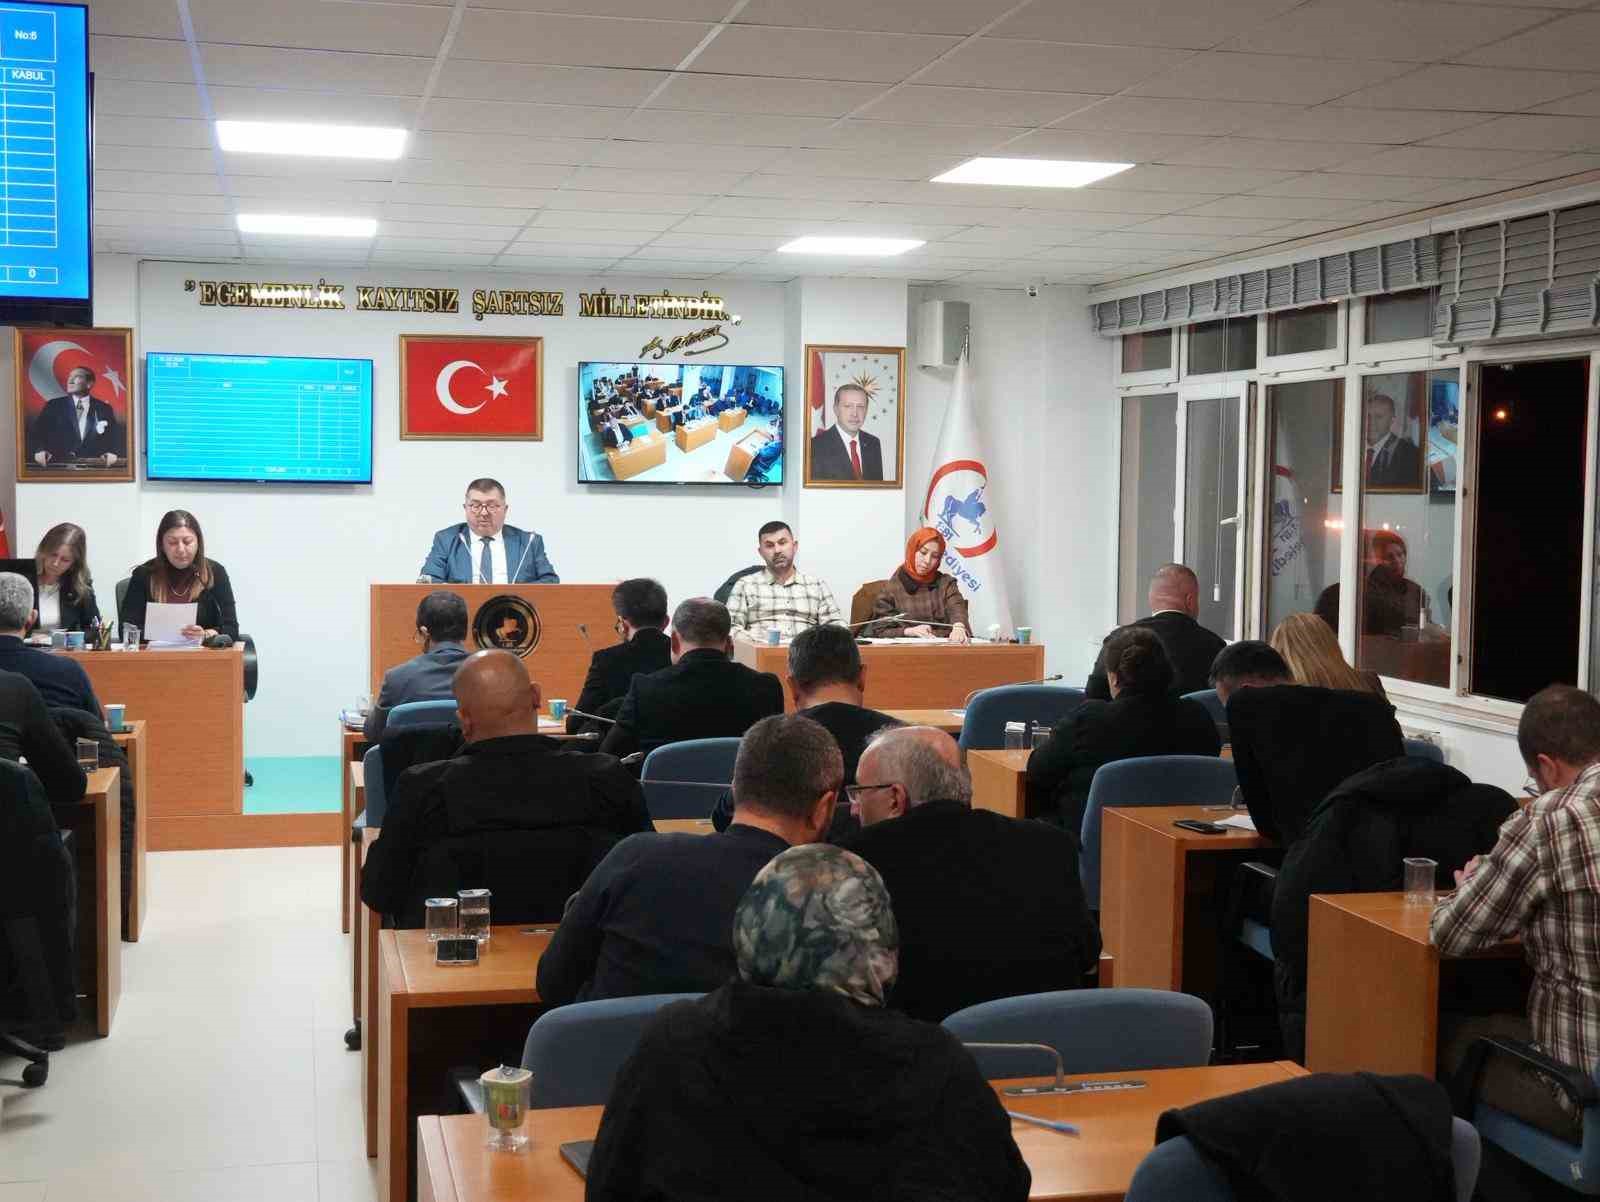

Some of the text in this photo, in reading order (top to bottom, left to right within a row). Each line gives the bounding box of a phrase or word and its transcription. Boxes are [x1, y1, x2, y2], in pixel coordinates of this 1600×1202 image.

[11, 69, 46, 81] KABUL
[356, 286, 459, 313] KAYITSIZ
[472, 289, 564, 321] ŞARTSIZ
